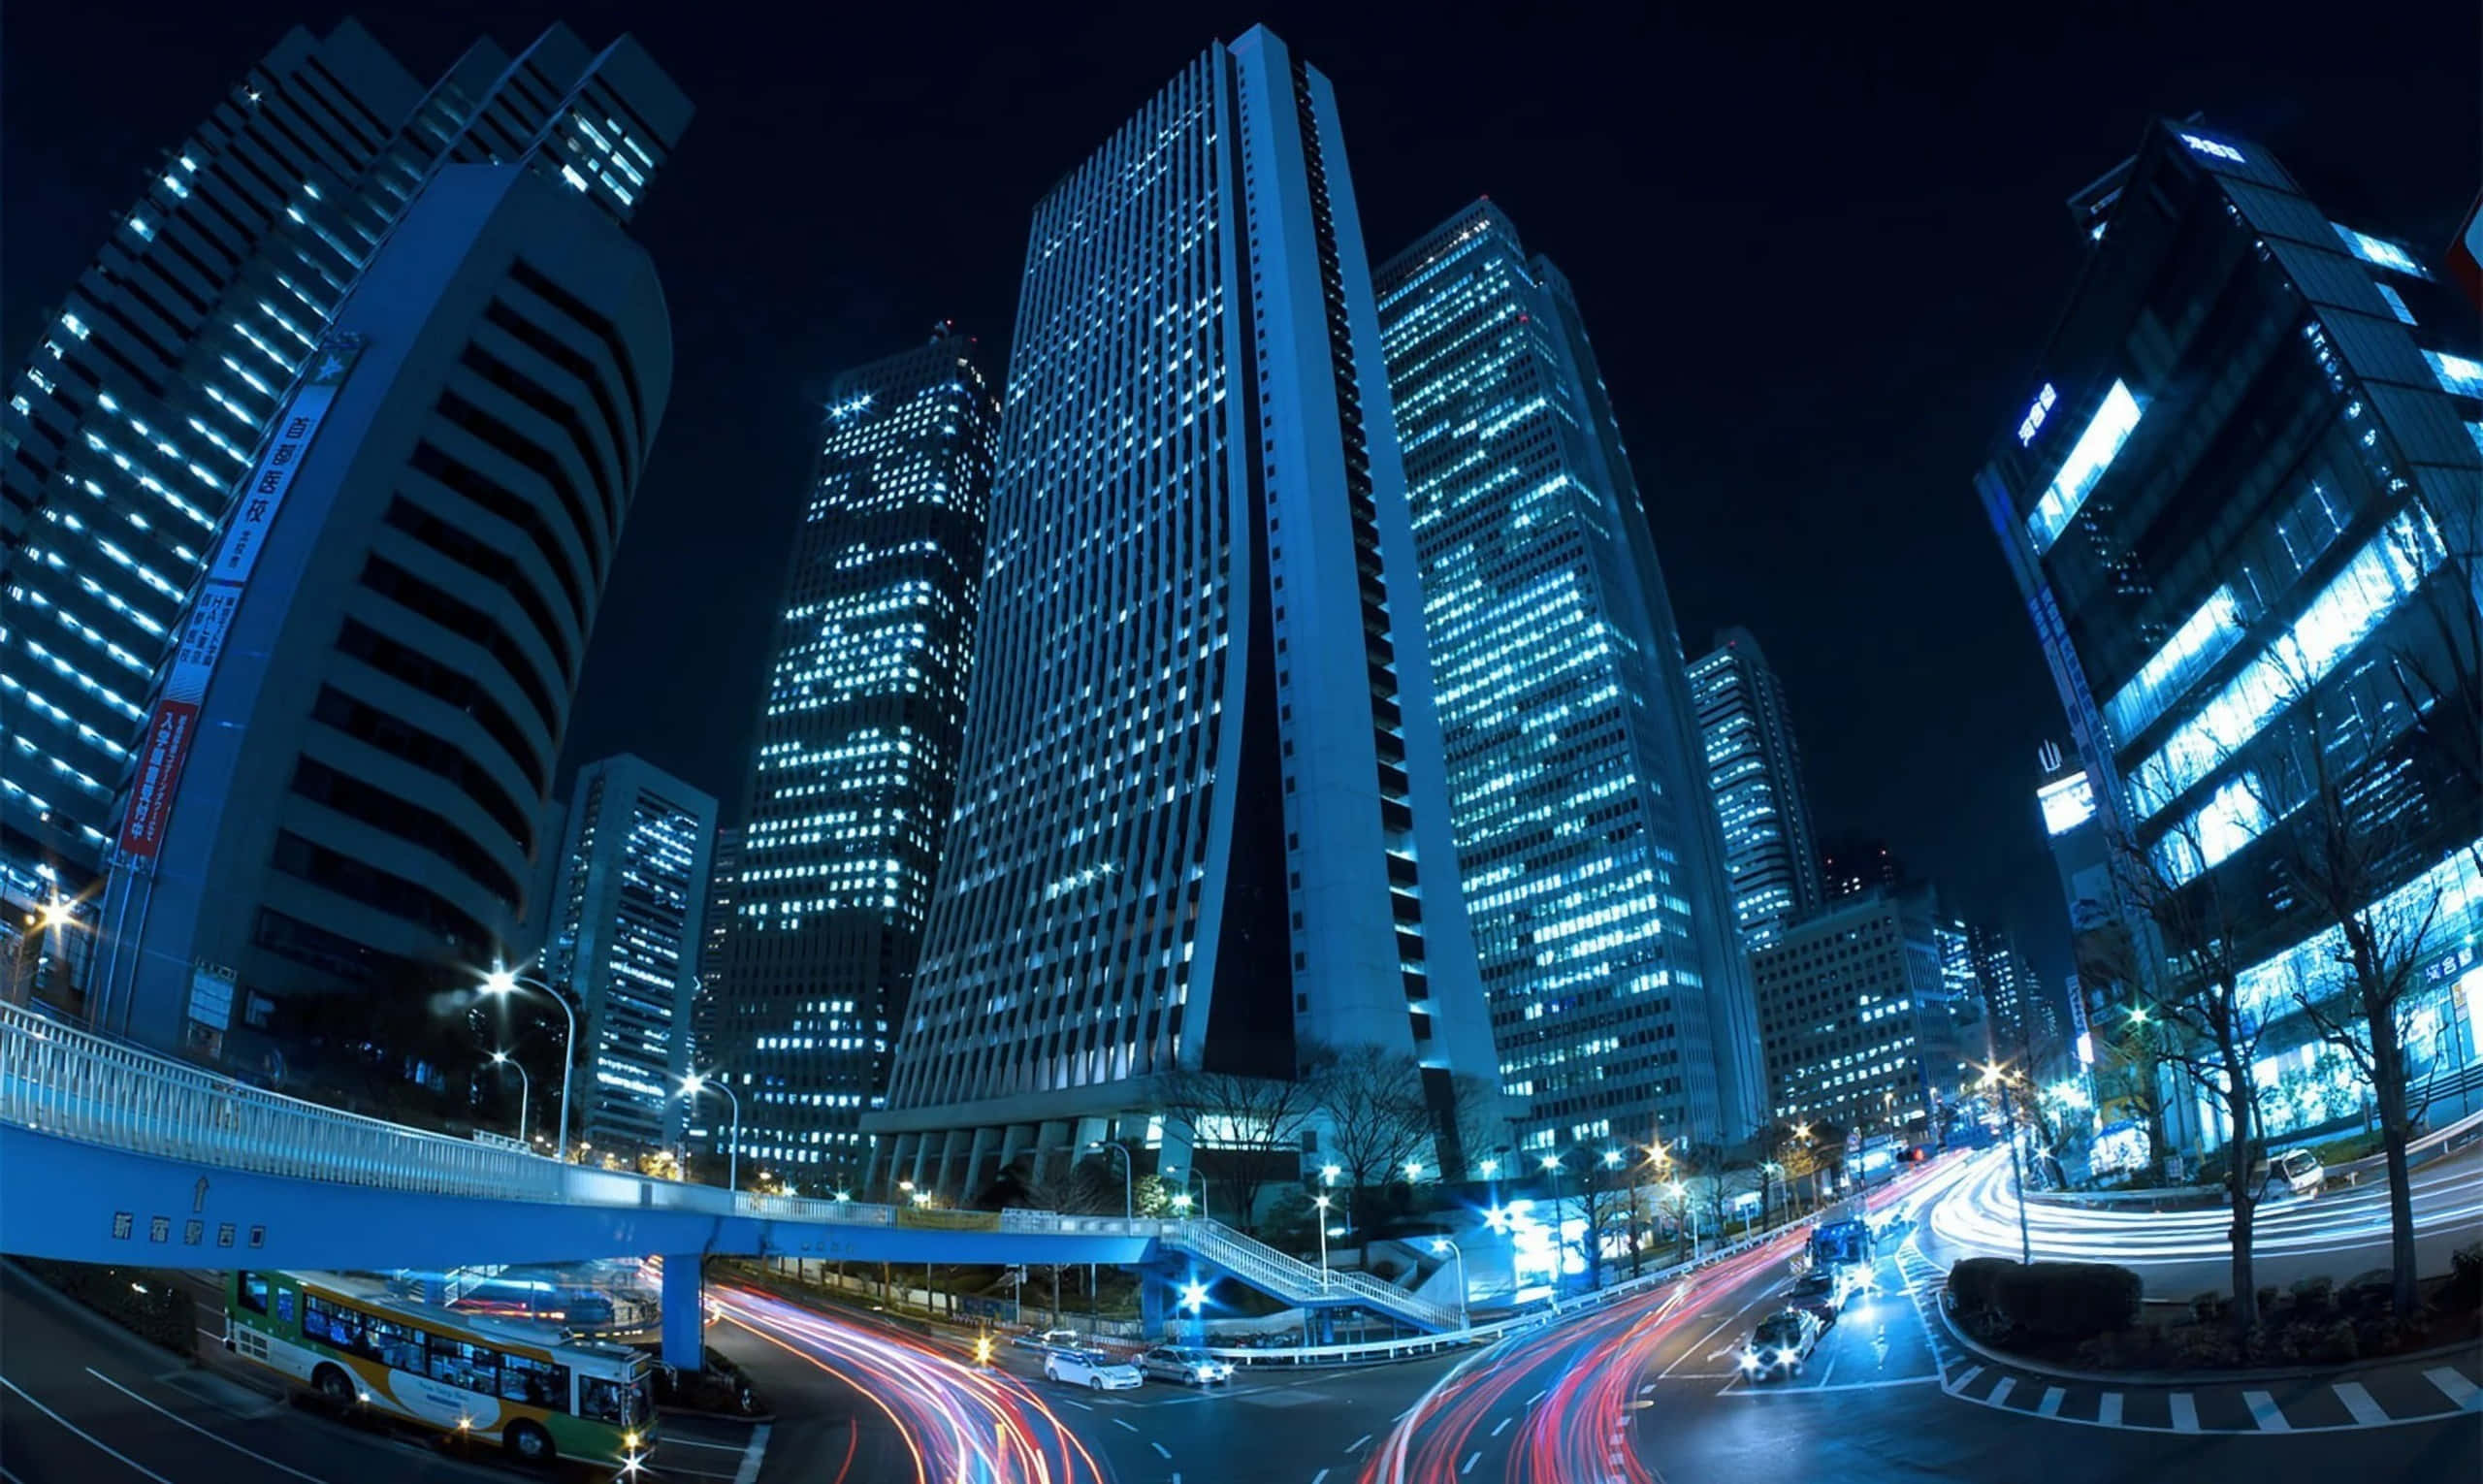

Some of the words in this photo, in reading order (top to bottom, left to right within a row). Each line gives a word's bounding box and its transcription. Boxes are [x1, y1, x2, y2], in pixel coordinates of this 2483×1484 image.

[113, 1211, 267, 1249] 新宿駅西口
